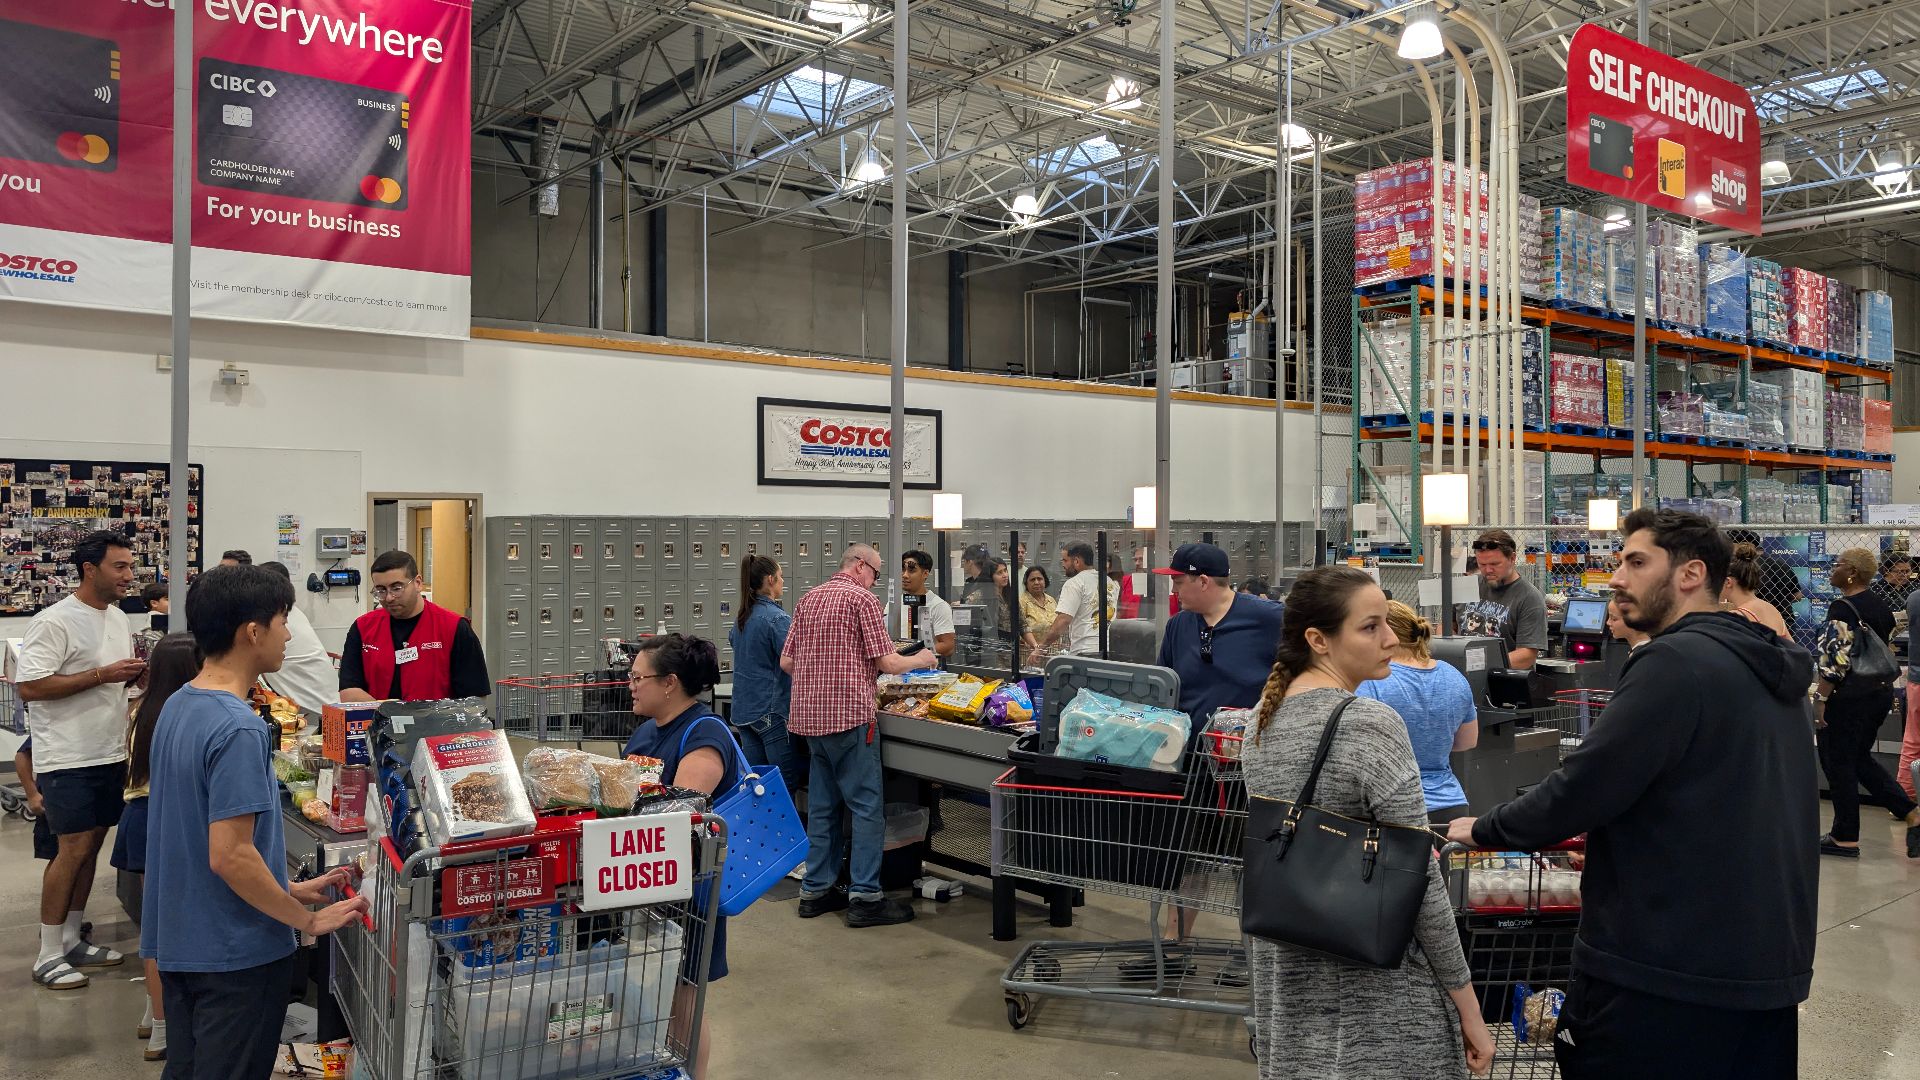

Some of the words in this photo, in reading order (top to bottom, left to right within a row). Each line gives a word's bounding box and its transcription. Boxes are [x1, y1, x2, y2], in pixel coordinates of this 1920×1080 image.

[205, 0, 443, 63] everywhere
[210, 73, 255, 94] CIBC
[357, 98, 396, 112] BUSINESS
[1589, 48, 1642, 103] SELF
[1646, 71, 1746, 143] CHECKOUT
[210, 158, 268, 174] CARDHOLDER
[269, 167, 295, 178] NAME
[210, 169, 254, 182] COMPANY
[255, 175, 281, 185] NAME
[1712, 170, 1746, 205] shop
[207, 196, 243, 219] For
[250, 207, 301, 225] your
[308, 209, 401, 238] business
[2, 269, 75, 283] WHOLESALE
[190, 279, 211, 290] Visit
[213, 281, 229, 291] the
[231, 283, 289, 298] membership
[291, 288, 311, 299] desk
[313, 292, 323, 300] or
[324, 291, 393, 307] cibc.com/costco
[395, 299, 404, 307] to
[426, 303, 448, 312] more
[833, 446, 890, 458] WHOLESA
[795, 457, 817, 471] Happy
[837, 459, 875, 472] Anniversary
[48, 507, 110, 518] ANNIVERSARY
[611, 827, 665, 857] LANE
[599, 860, 677, 893] CLOSED
[457, 894, 491, 905] COSTCO
